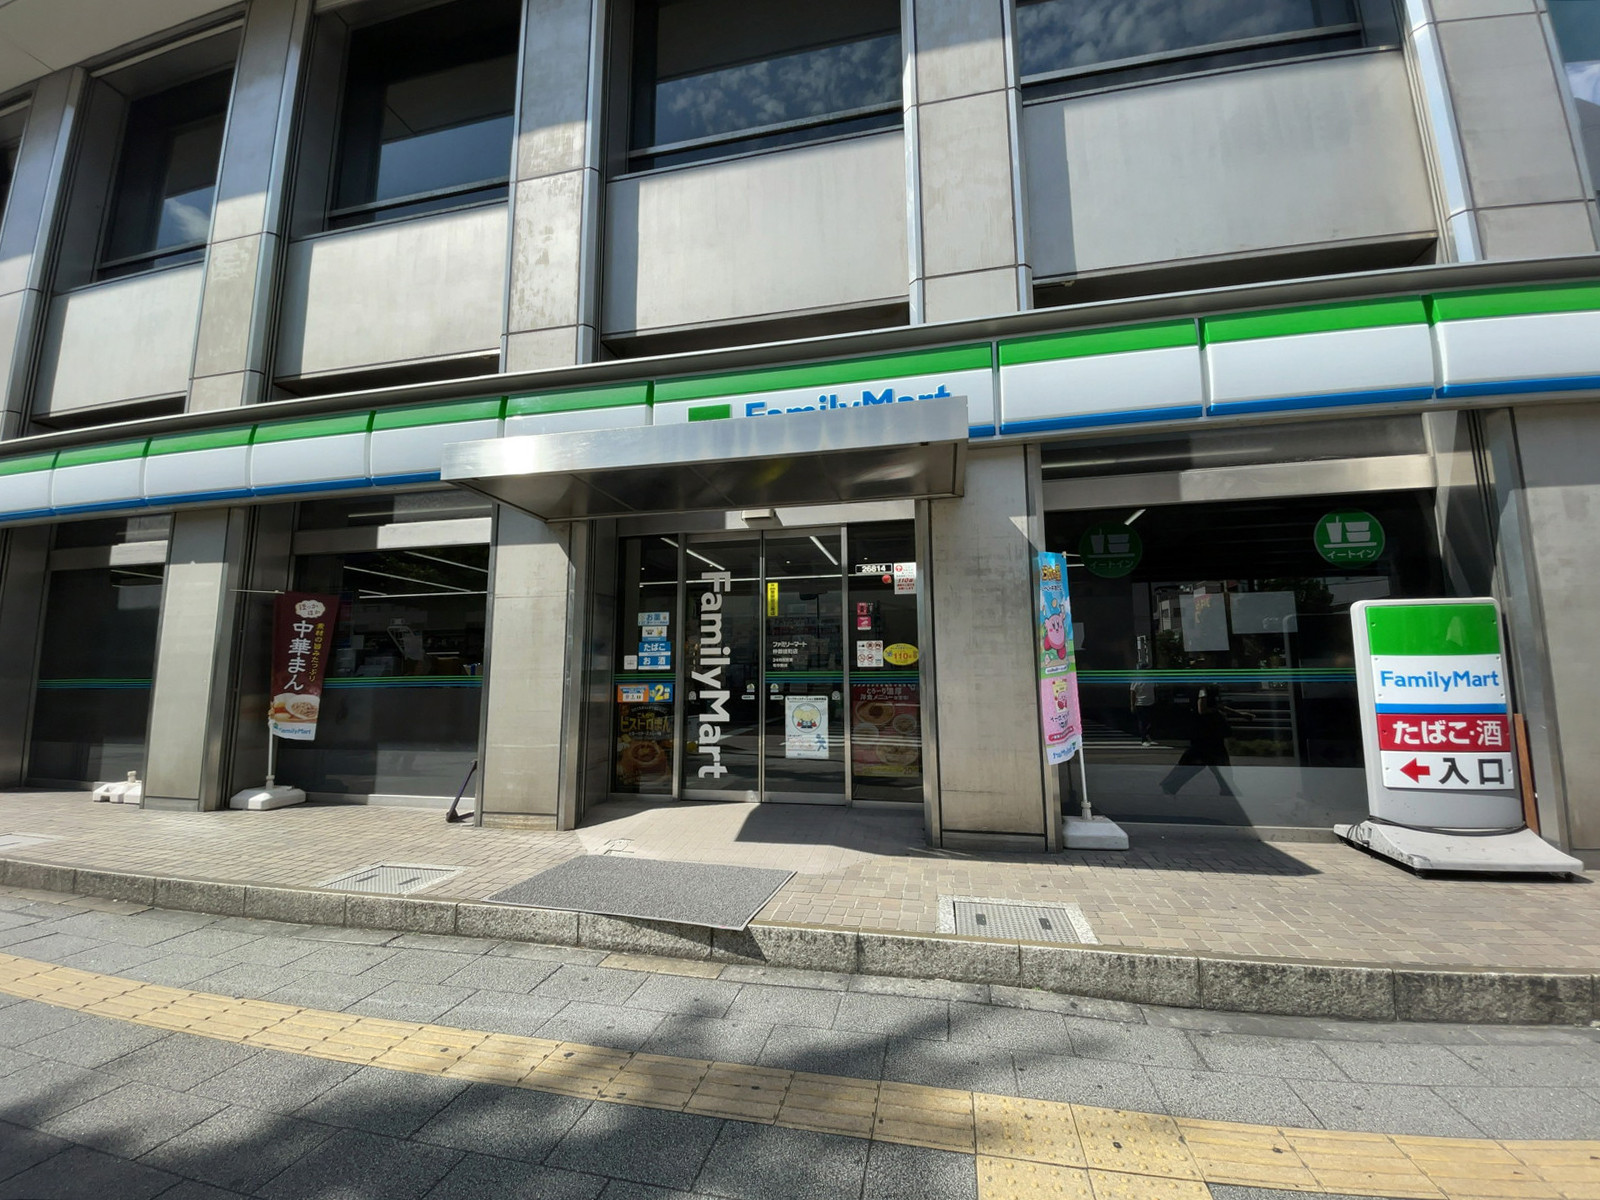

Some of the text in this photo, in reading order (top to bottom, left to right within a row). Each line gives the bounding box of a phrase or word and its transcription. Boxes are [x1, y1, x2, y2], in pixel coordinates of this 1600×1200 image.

[745, 384, 950, 418] FilMt
[1089, 559, 1134, 569] イートイン
[1326, 549, 1376, 559] イートイン
[862, 565, 886, 573] 26814
[284, 620, 314, 691] 中華まん
[643, 643, 666, 652] たばこ
[691, 571, 731, 779] FamilyMart
[1379, 670, 1500, 692] FamilyMart
[1391, 719, 1503, 747] たばこ・酒
[1438, 757, 1505, 785] 入口
